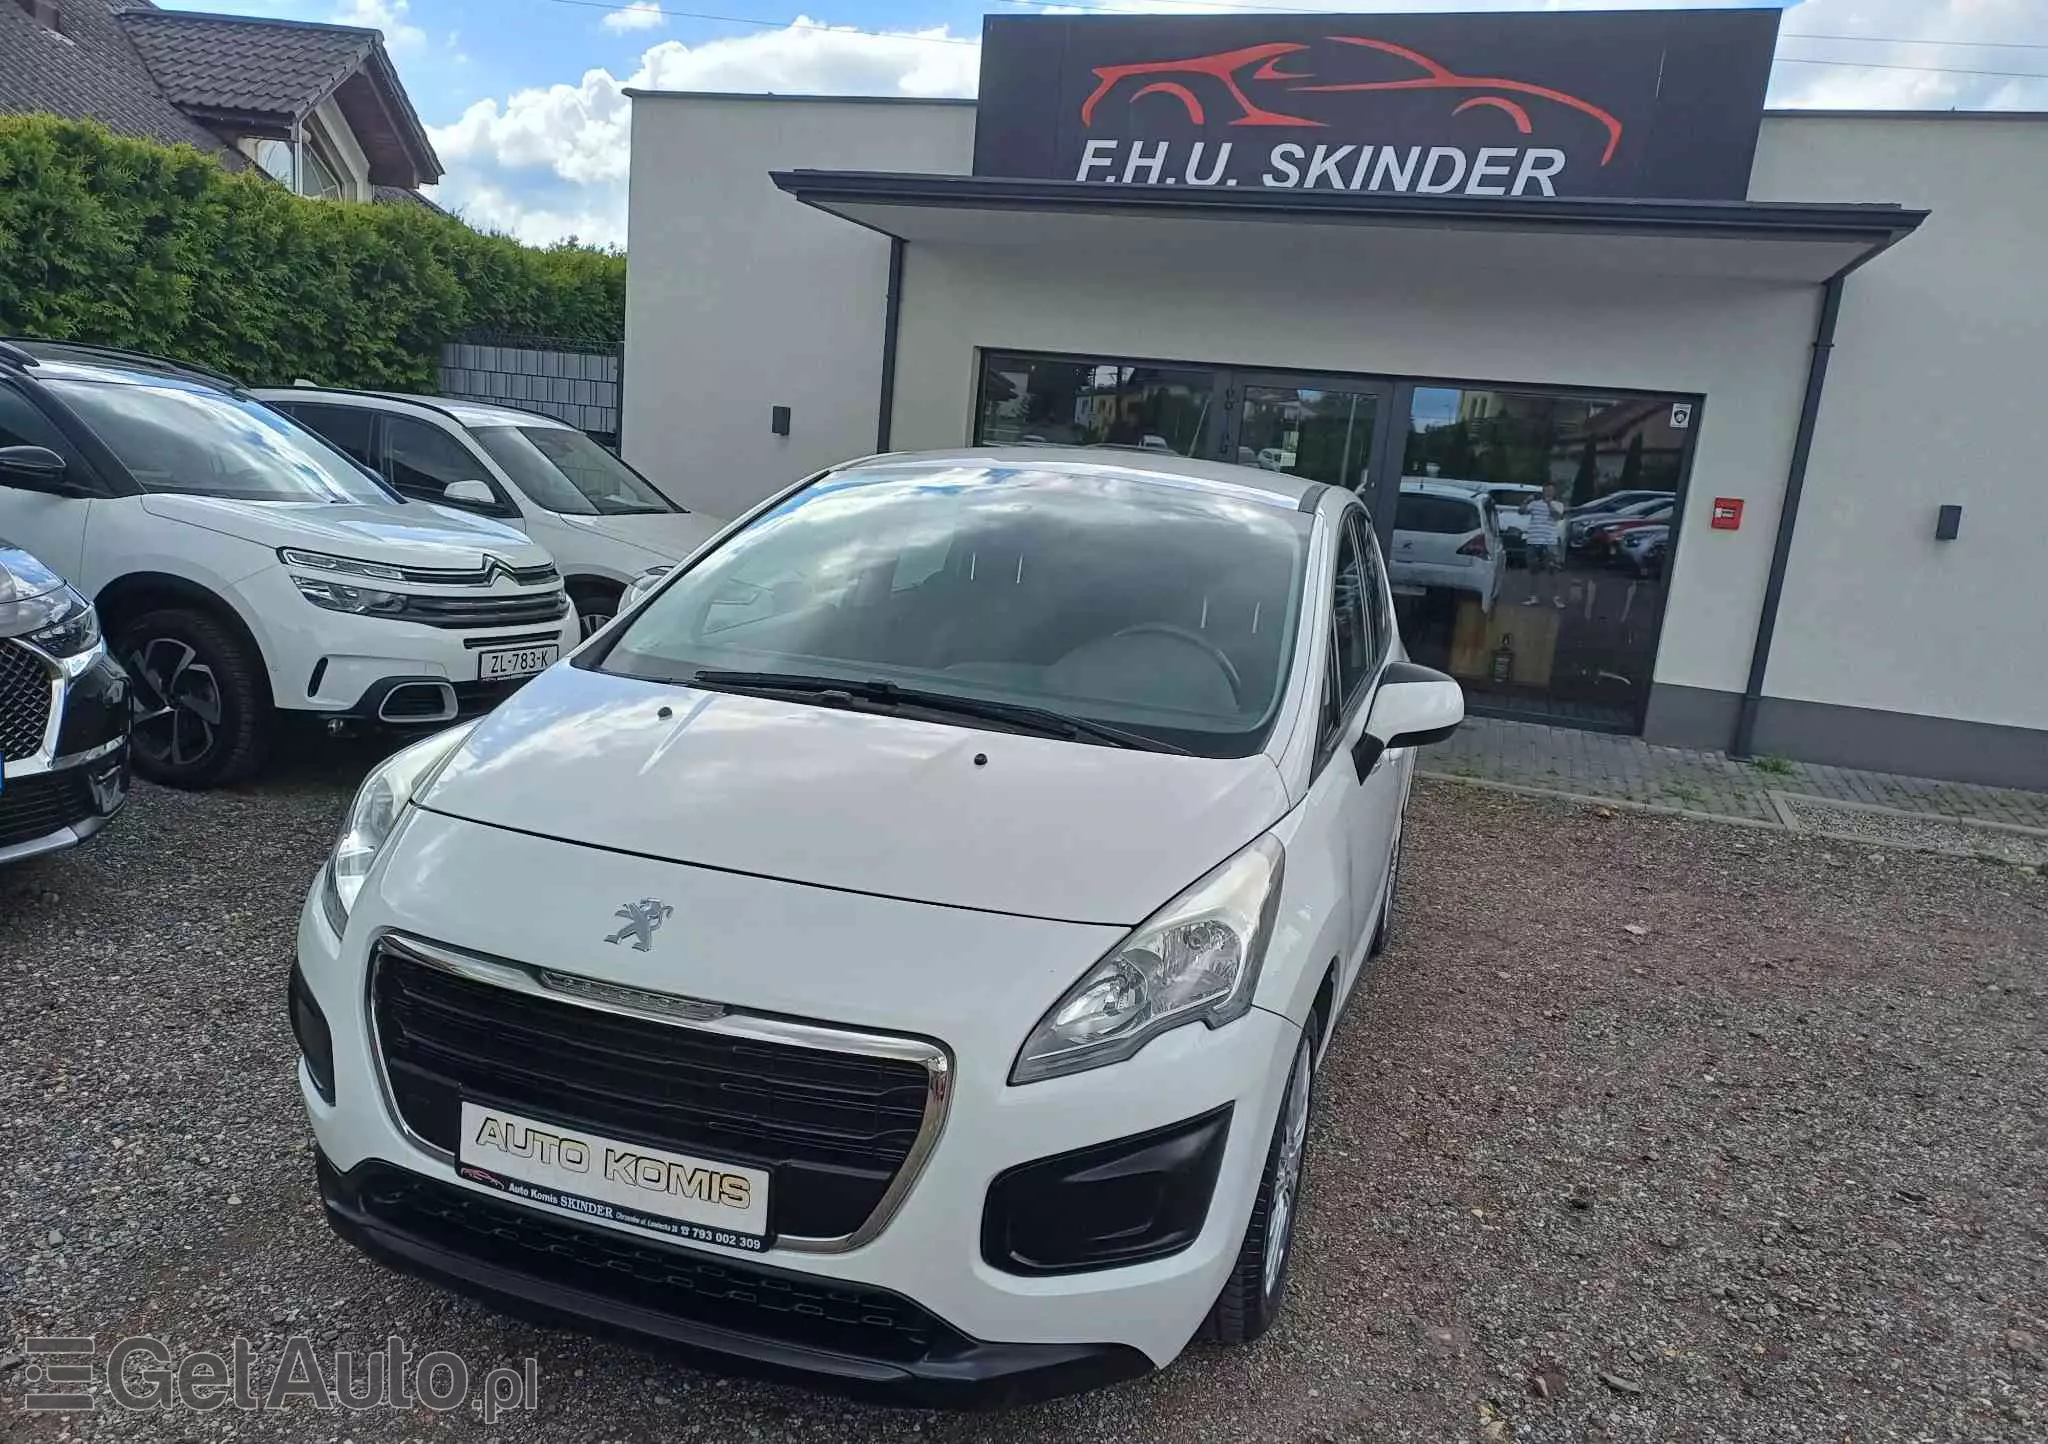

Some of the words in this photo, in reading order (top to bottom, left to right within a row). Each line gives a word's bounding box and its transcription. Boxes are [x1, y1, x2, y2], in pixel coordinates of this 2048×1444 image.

[1075, 138, 1237, 186] F.H.U.
[1262, 143, 1567, 198] SKINDER
[475, 1116, 591, 1174] AUTO
[604, 1148, 751, 1210] KOMIS
[508, 1182, 530, 1196] Auto
[530, 1188, 558, 1204] Komis
[560, 1196, 614, 1219] SKINDER
[691, 1228, 713, 1241] 793
[716, 1233, 737, 1246] 002
[739, 1237, 761, 1250] 309
